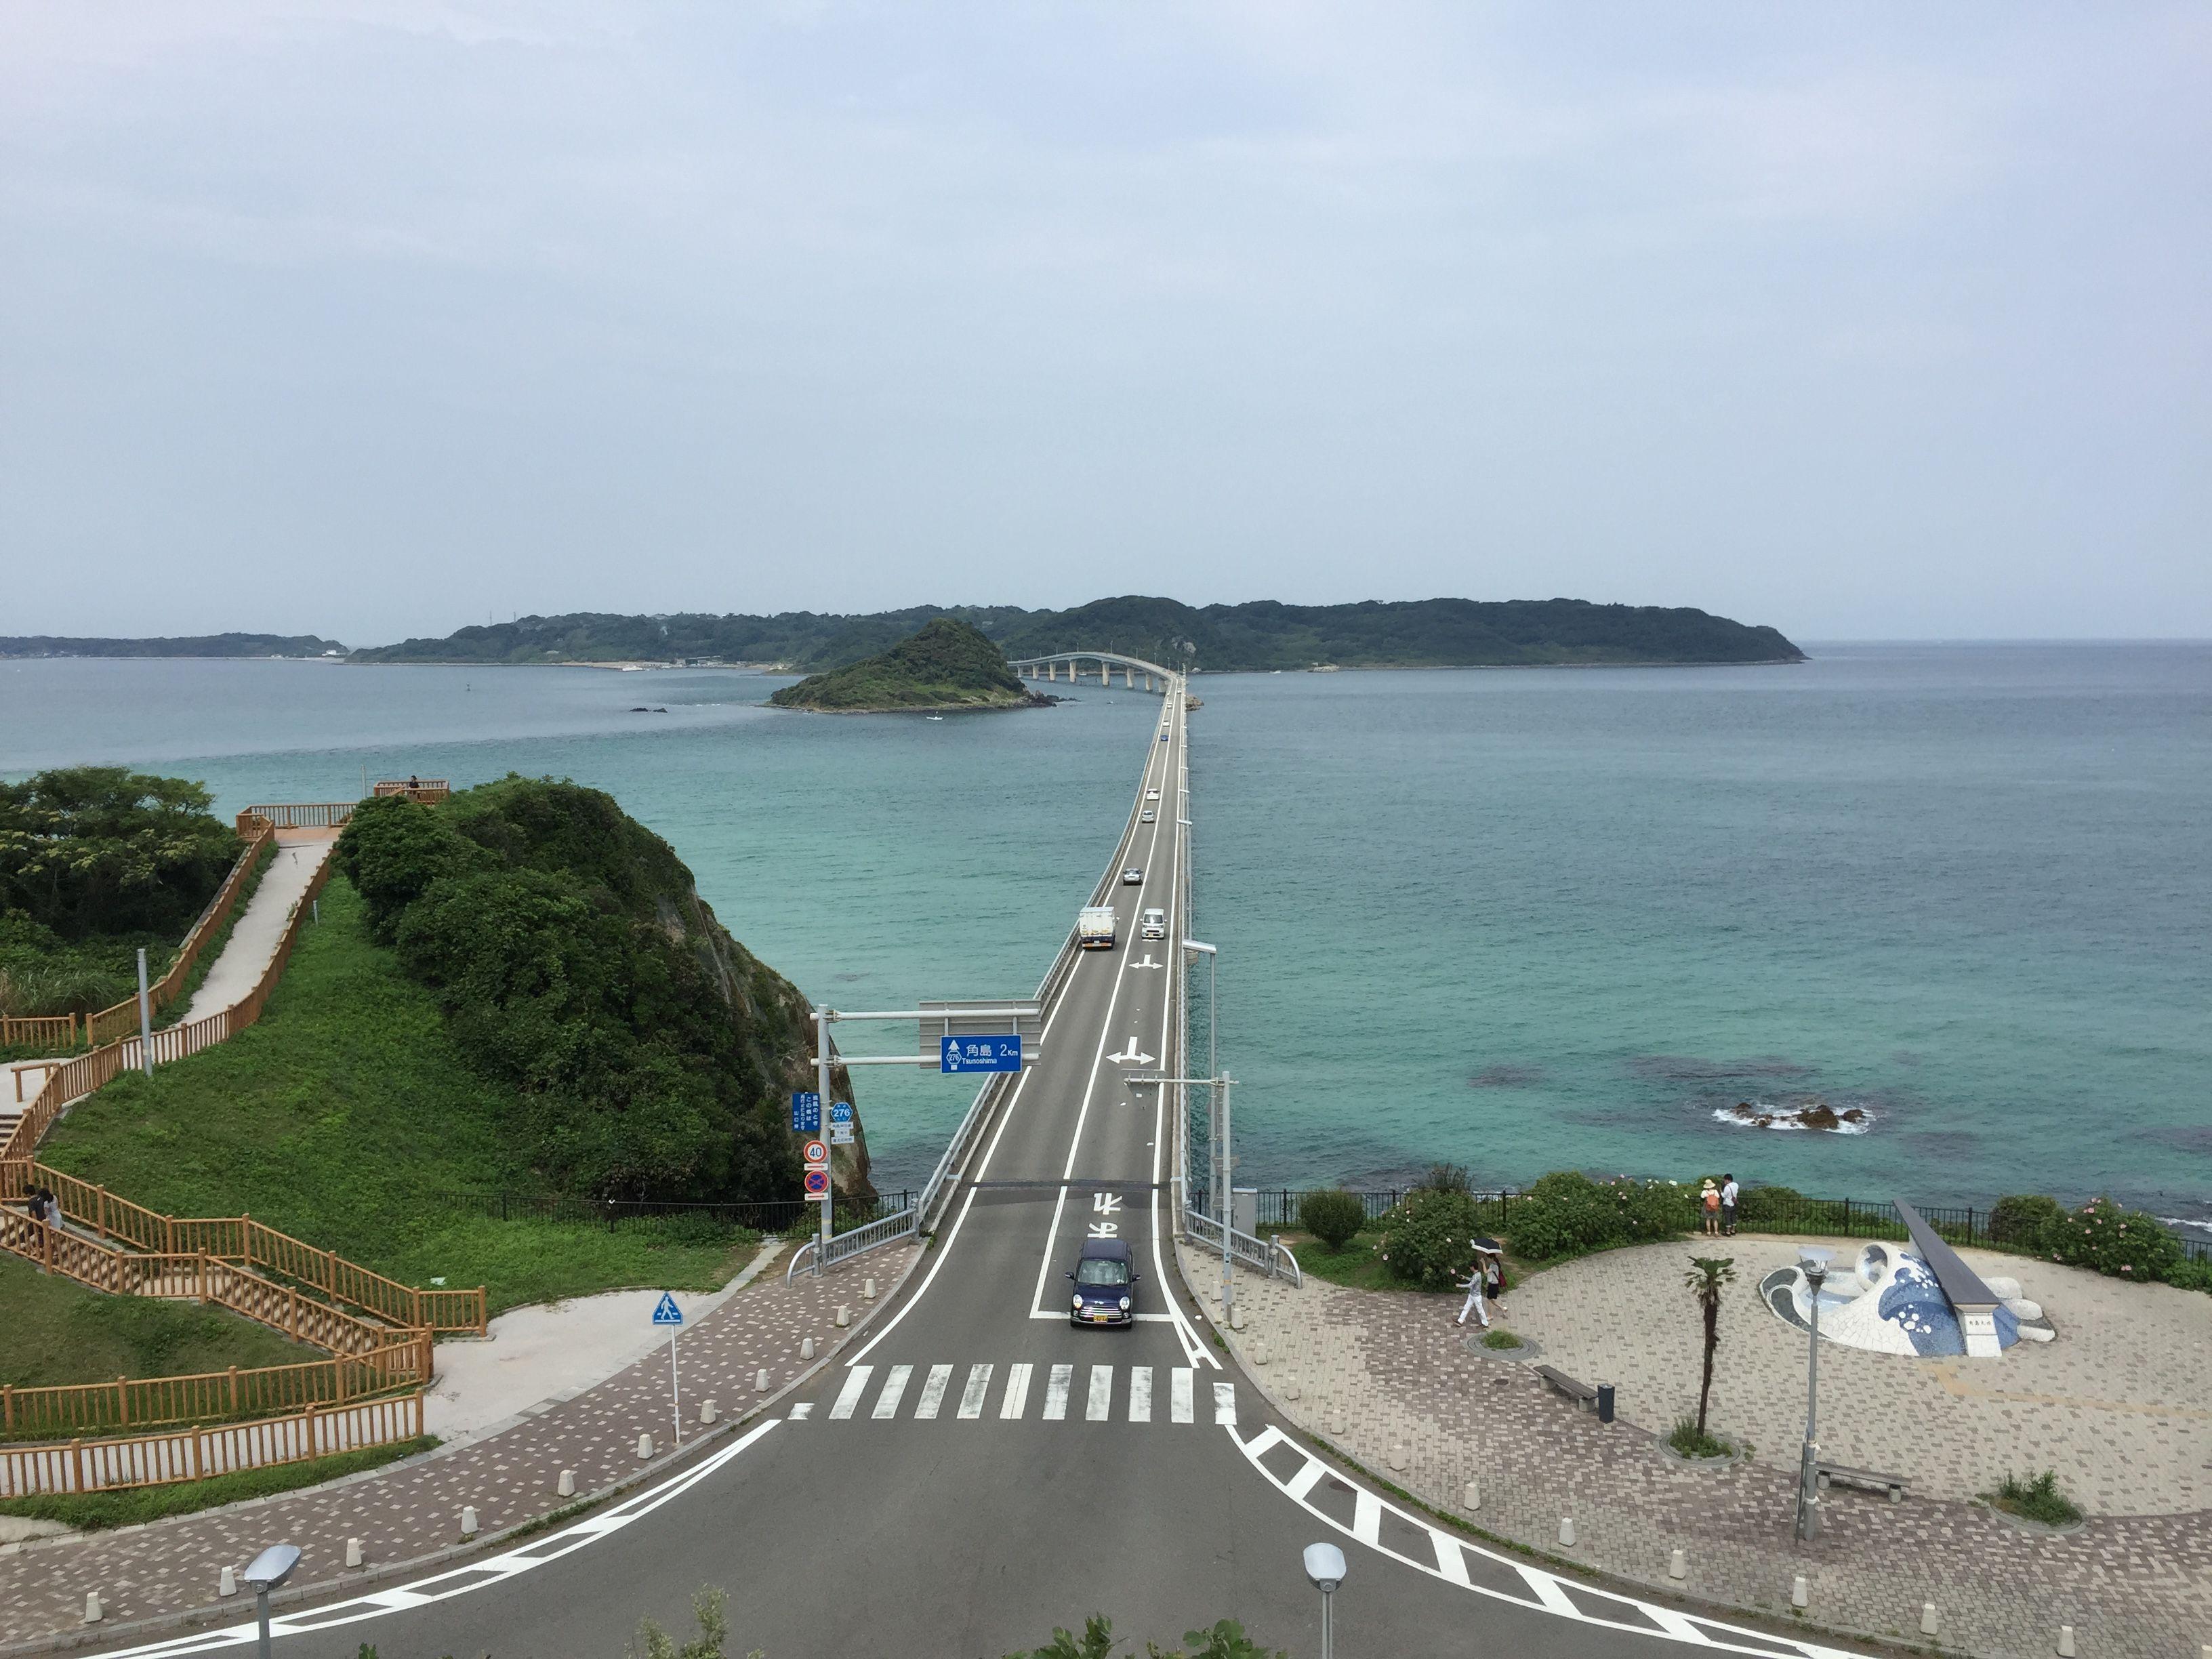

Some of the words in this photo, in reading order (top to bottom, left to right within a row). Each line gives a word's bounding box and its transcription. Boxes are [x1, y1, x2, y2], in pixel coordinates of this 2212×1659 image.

[966, 1044, 992, 1057] 角島
[833, 1108, 851, 1117] 276
[810, 1147, 822, 1158] 40
